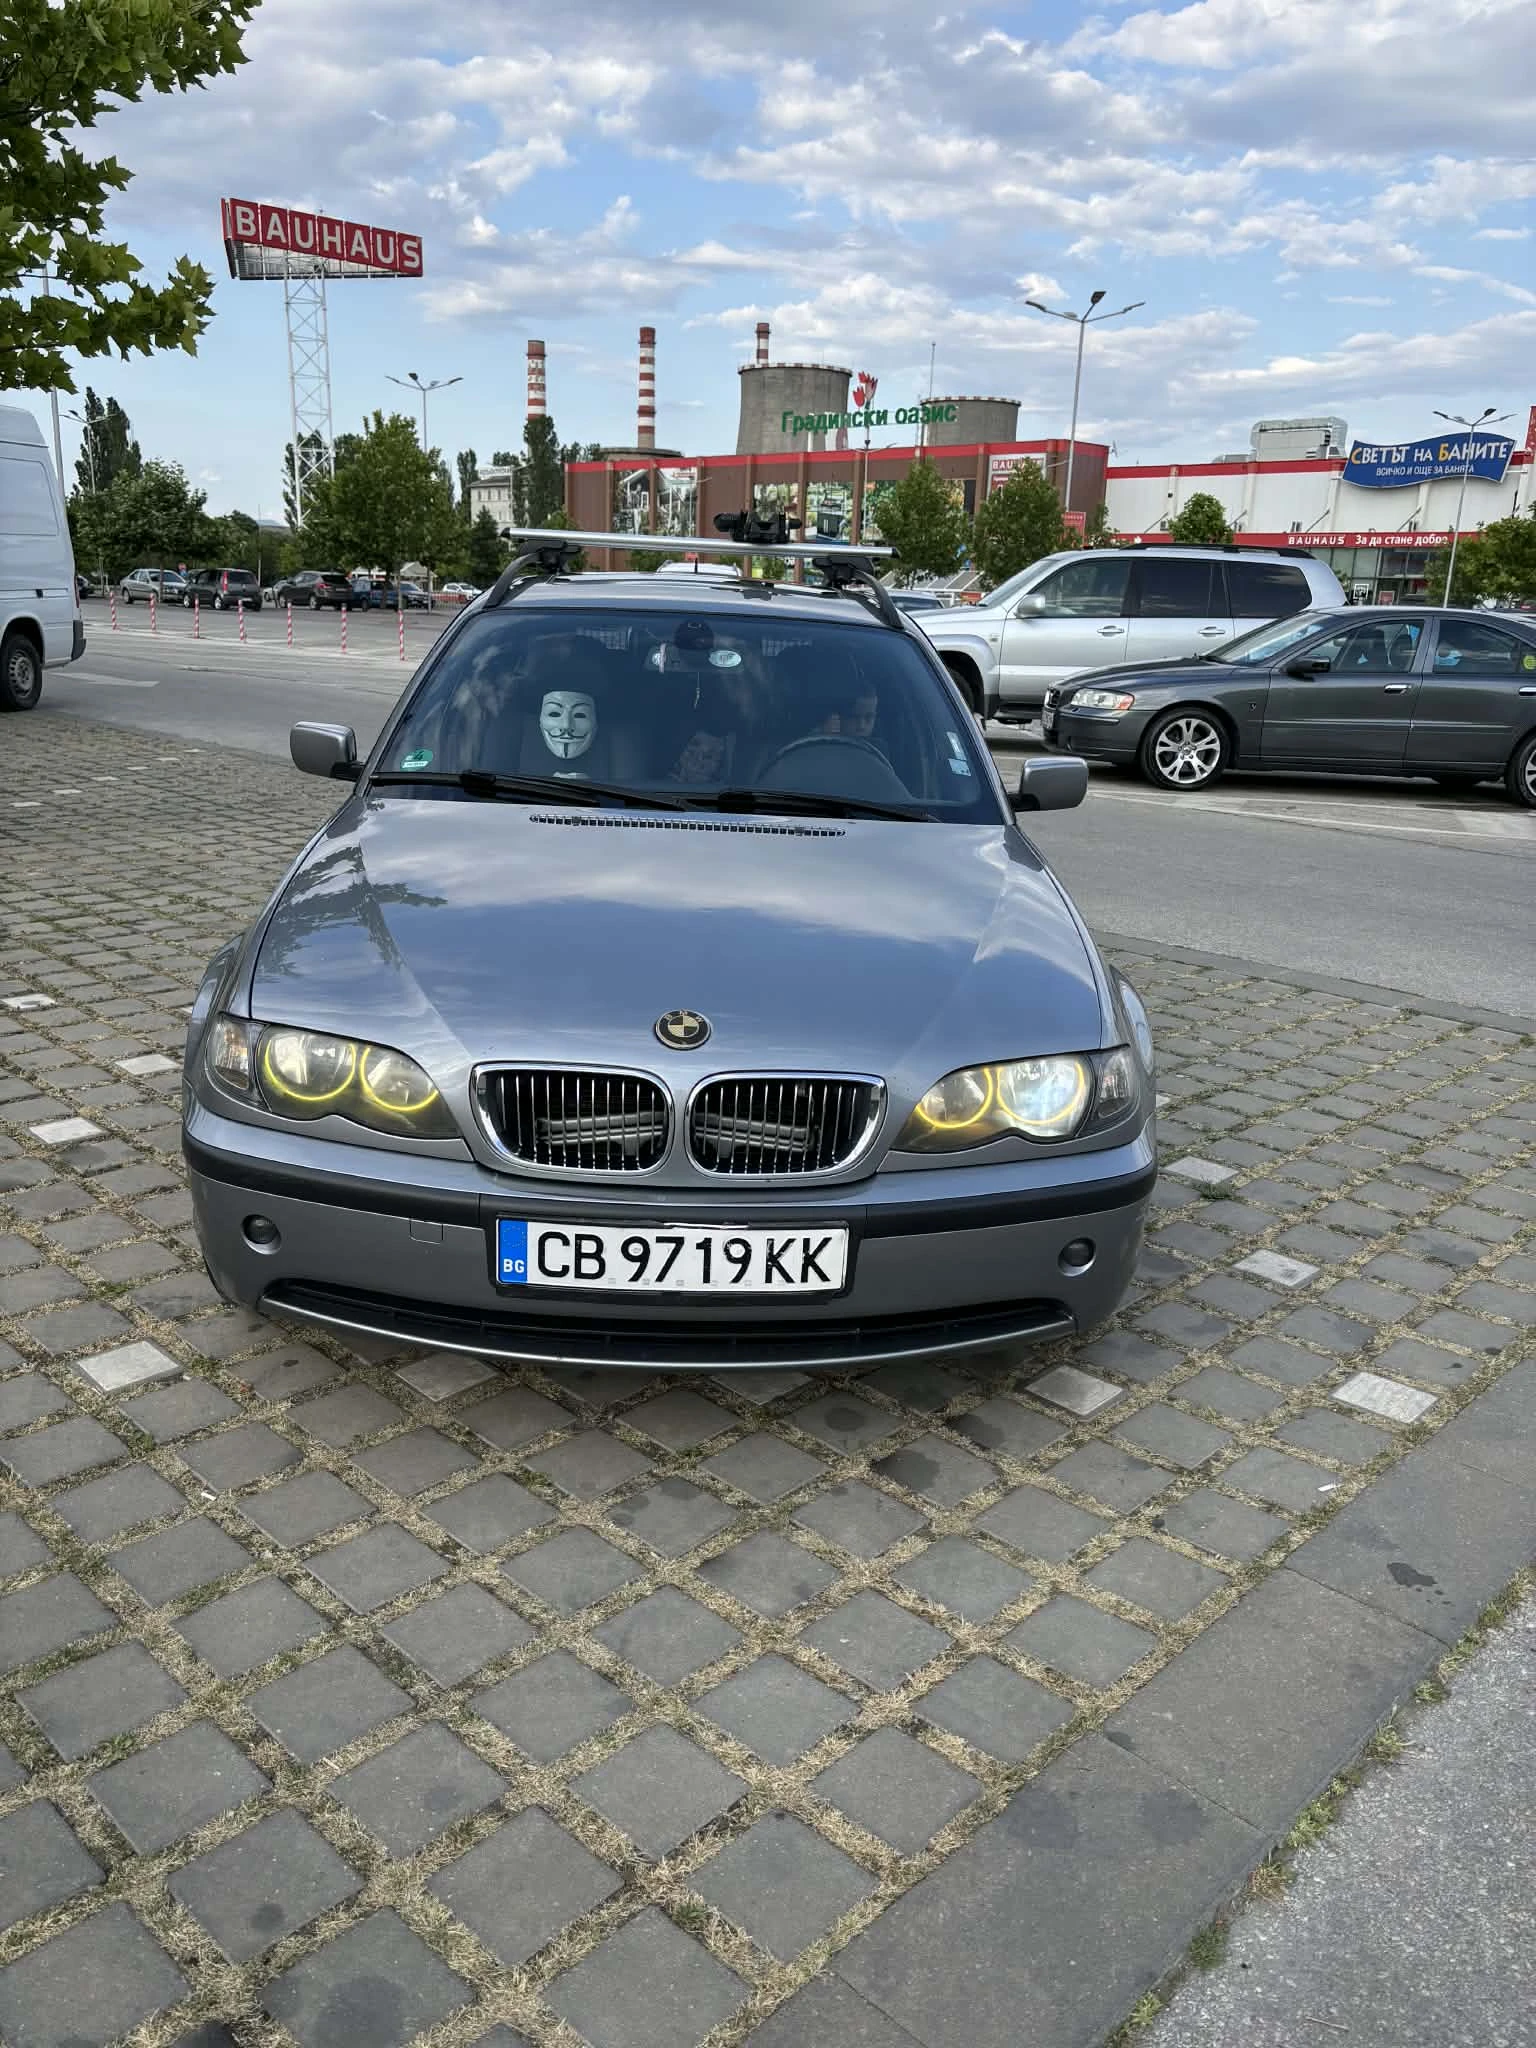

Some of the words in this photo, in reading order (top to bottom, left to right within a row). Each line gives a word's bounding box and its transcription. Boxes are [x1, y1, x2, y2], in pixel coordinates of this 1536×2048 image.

[235, 206, 421, 269] BAUHAUS
[781, 409, 888, 436] Градински
[895, 404, 958, 424] оазис
[1351, 446, 1410, 464] СВЕТЪТ
[1414, 449, 1433, 462] НА
[1438, 442, 1507, 462] БАНИТЕ
[1288, 536, 1345, 545] BAUHAUS
[1355, 534, 1368, 545] За
[1369, 536, 1382, 547] да
[1384, 536, 1413, 545] стане
[503, 1259, 525, 1273] BG
[620, 1236, 753, 1284] 9719
[764, 1237, 833, 1284] KK
